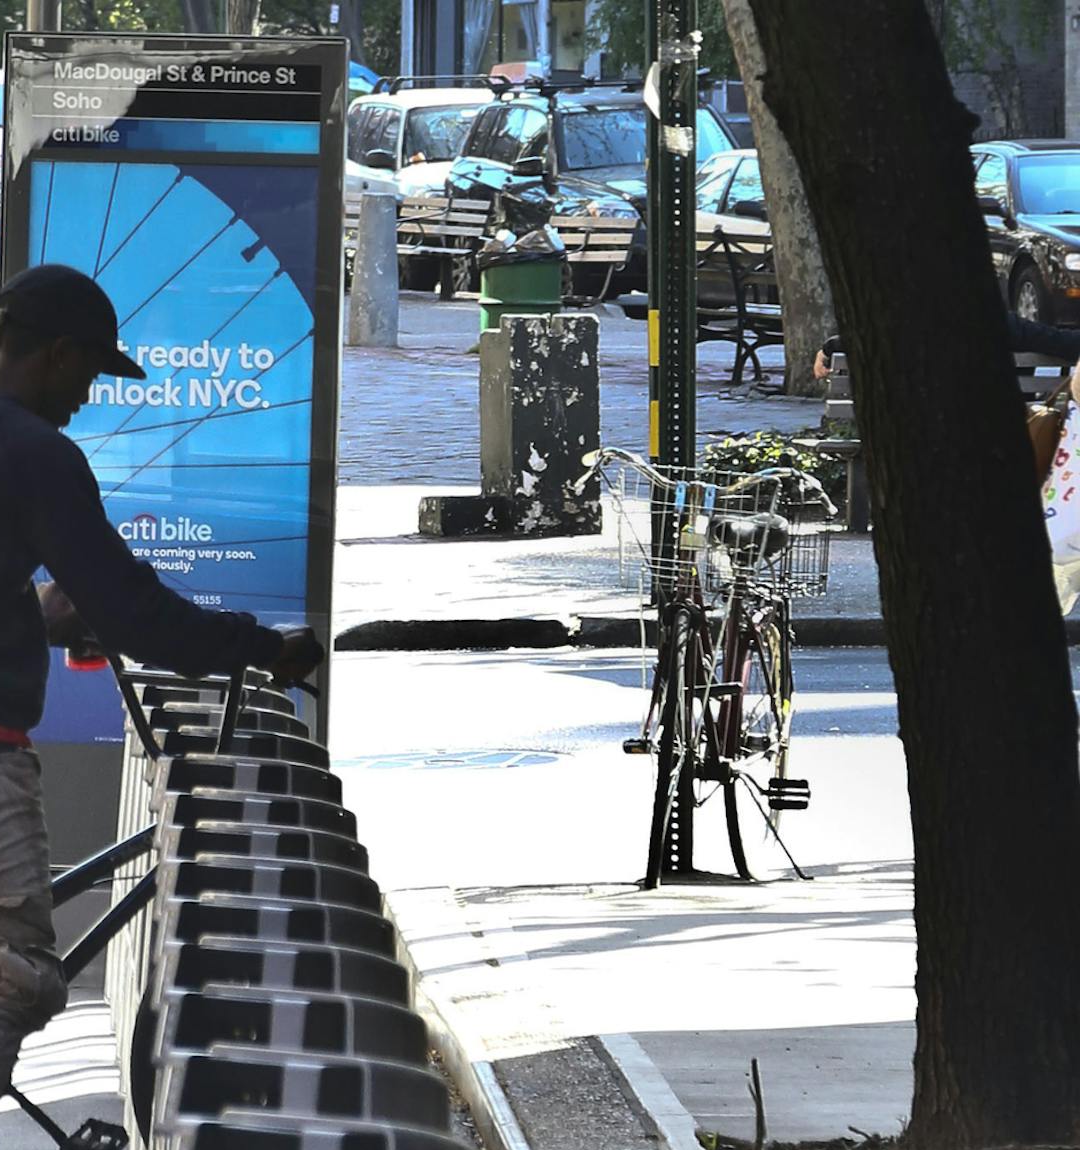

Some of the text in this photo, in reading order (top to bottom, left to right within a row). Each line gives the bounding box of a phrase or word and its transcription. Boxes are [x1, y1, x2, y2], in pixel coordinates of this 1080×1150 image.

[54, 62, 296, 84] MacDougal St & Prince St
[52, 91, 102, 109] Soho
[137, 339, 274, 378] ready to
[189, 379, 270, 408] NYC.
[132, 547, 256, 562] are coming very soon.
[152, 559, 194, 573] riously.
[193, 595, 221, 605] 55155
